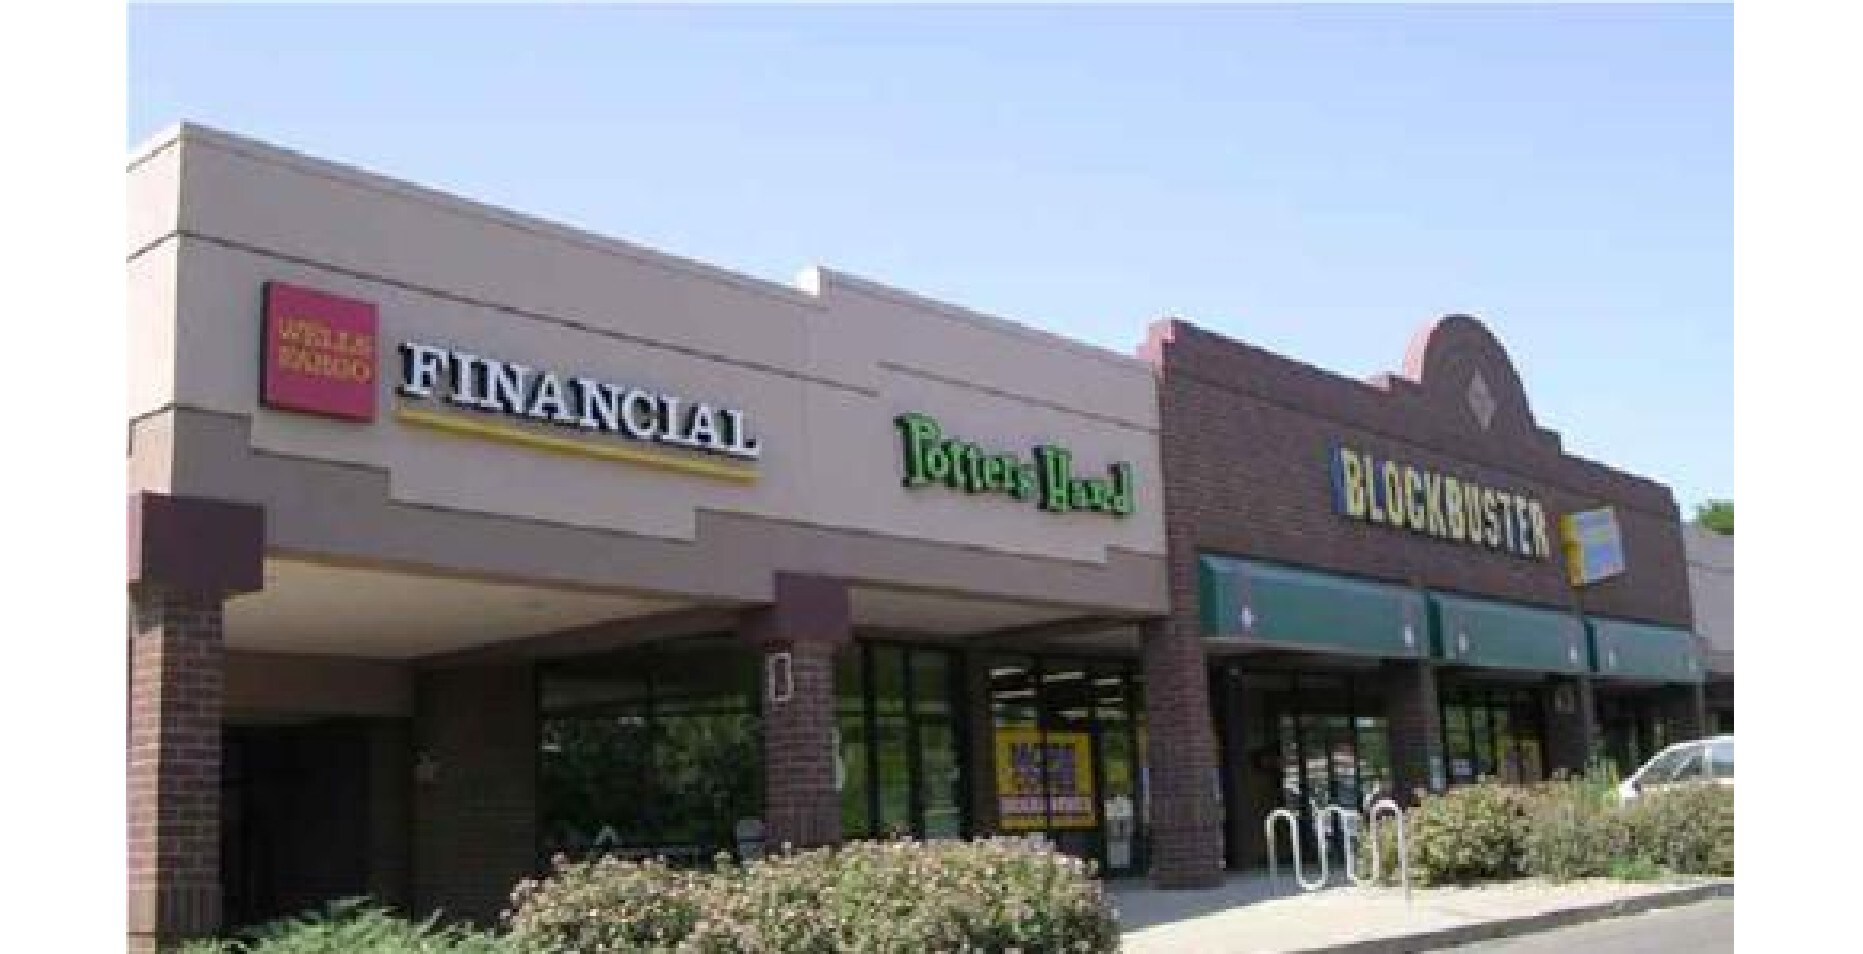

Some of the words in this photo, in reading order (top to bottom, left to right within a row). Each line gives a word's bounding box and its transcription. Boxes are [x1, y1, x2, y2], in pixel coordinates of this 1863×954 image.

[398, 340, 760, 459] FINANCIAL
[895, 410, 1038, 501] Potters
[1333, 446, 1550, 559] BLOCKBUSTER
